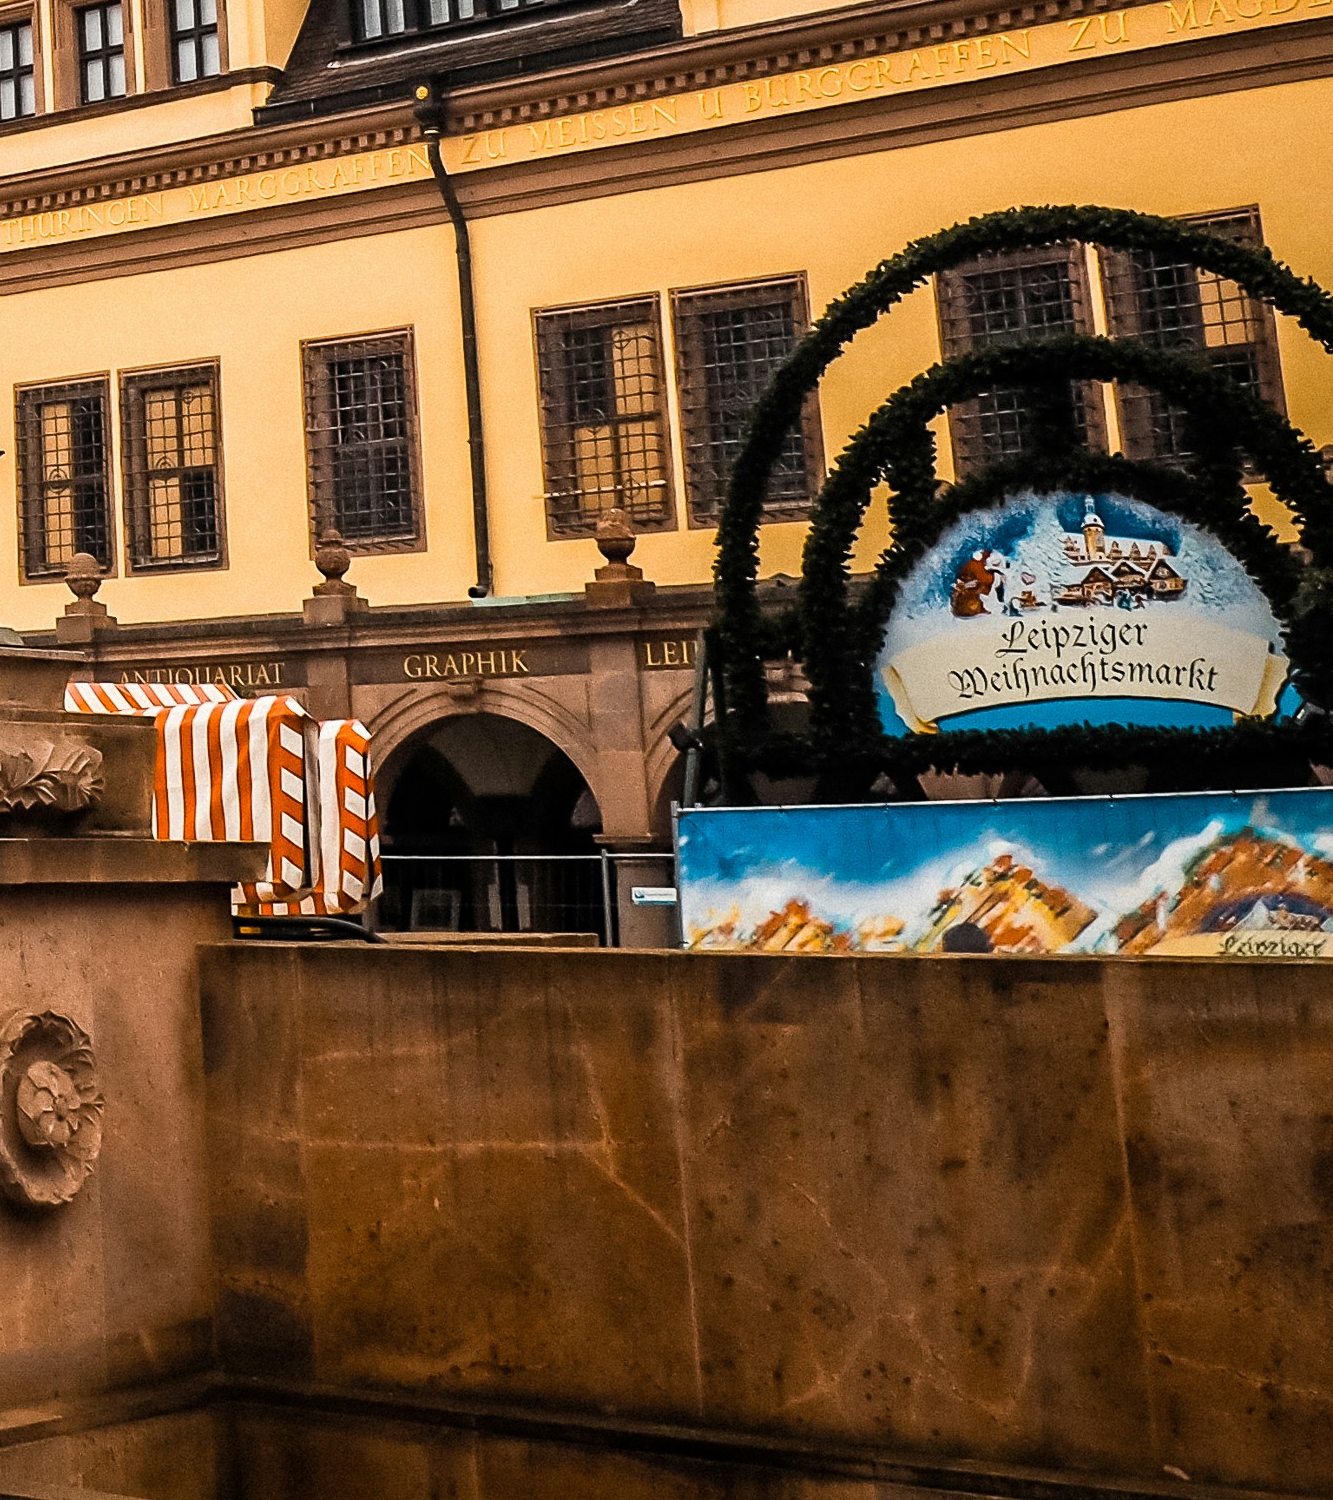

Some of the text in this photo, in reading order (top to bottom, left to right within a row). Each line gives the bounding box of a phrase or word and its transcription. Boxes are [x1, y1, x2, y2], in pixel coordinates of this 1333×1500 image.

[459, 132, 507, 165] ZU
[527, 98, 679, 153] MEISSEN
[742, 30, 1031, 114] BURGGRAFFEN
[1067, 12, 1130, 52] ZU
[995, 615, 1150, 658] Leipziger
[403, 649, 530, 678] GRAPHIK
[948, 651, 1220, 699] Weihnachtsmarkt
